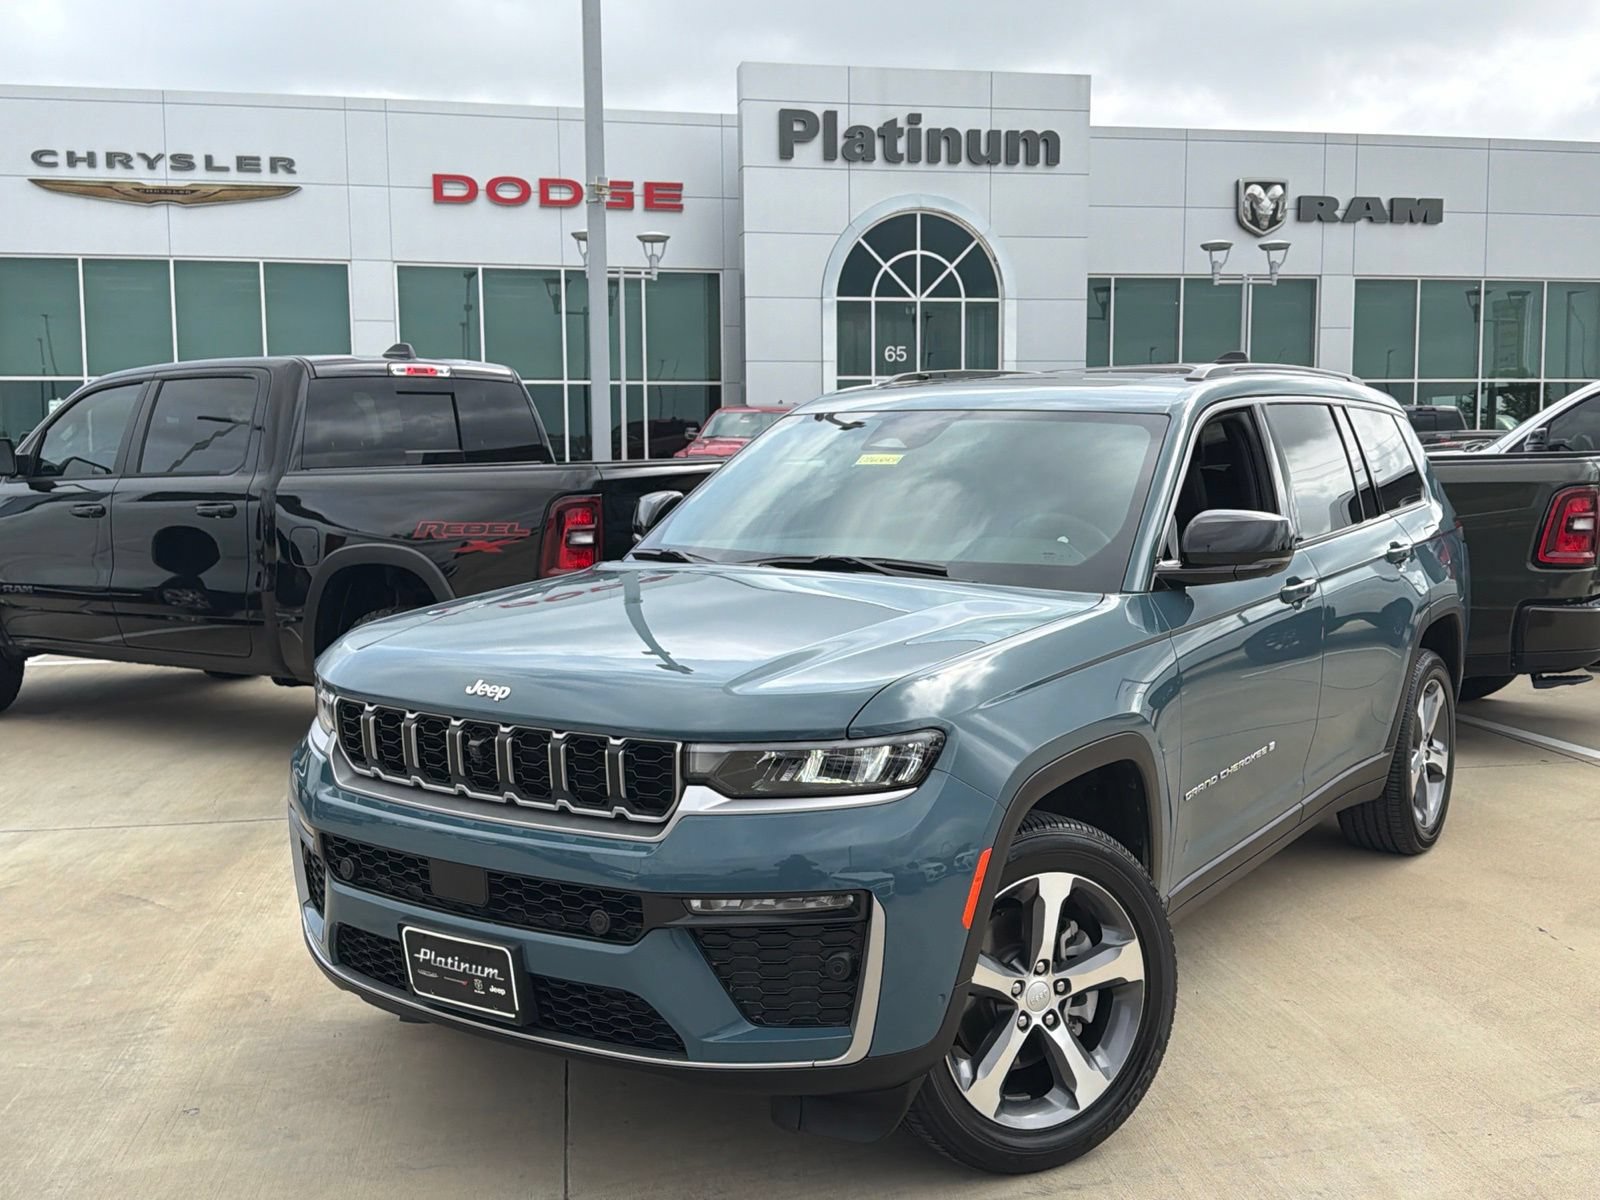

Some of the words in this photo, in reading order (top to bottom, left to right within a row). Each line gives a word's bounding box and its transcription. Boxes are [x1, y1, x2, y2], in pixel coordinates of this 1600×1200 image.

[778, 108, 1061, 168] Platinum
[31, 149, 297, 174] CHRYSLER
[432, 173, 684, 212] DODGE
[1297, 195, 1444, 225] RAM
[884, 345, 908, 363] 65
[412, 520, 531, 540] REBEL
[465, 679, 511, 701] Jeep
[1184, 775, 1219, 801] GRAND
[1220, 745, 1268, 780] CHEROKEE
[414, 948, 504, 980] Platinum
[489, 985, 505, 995] Jeep
